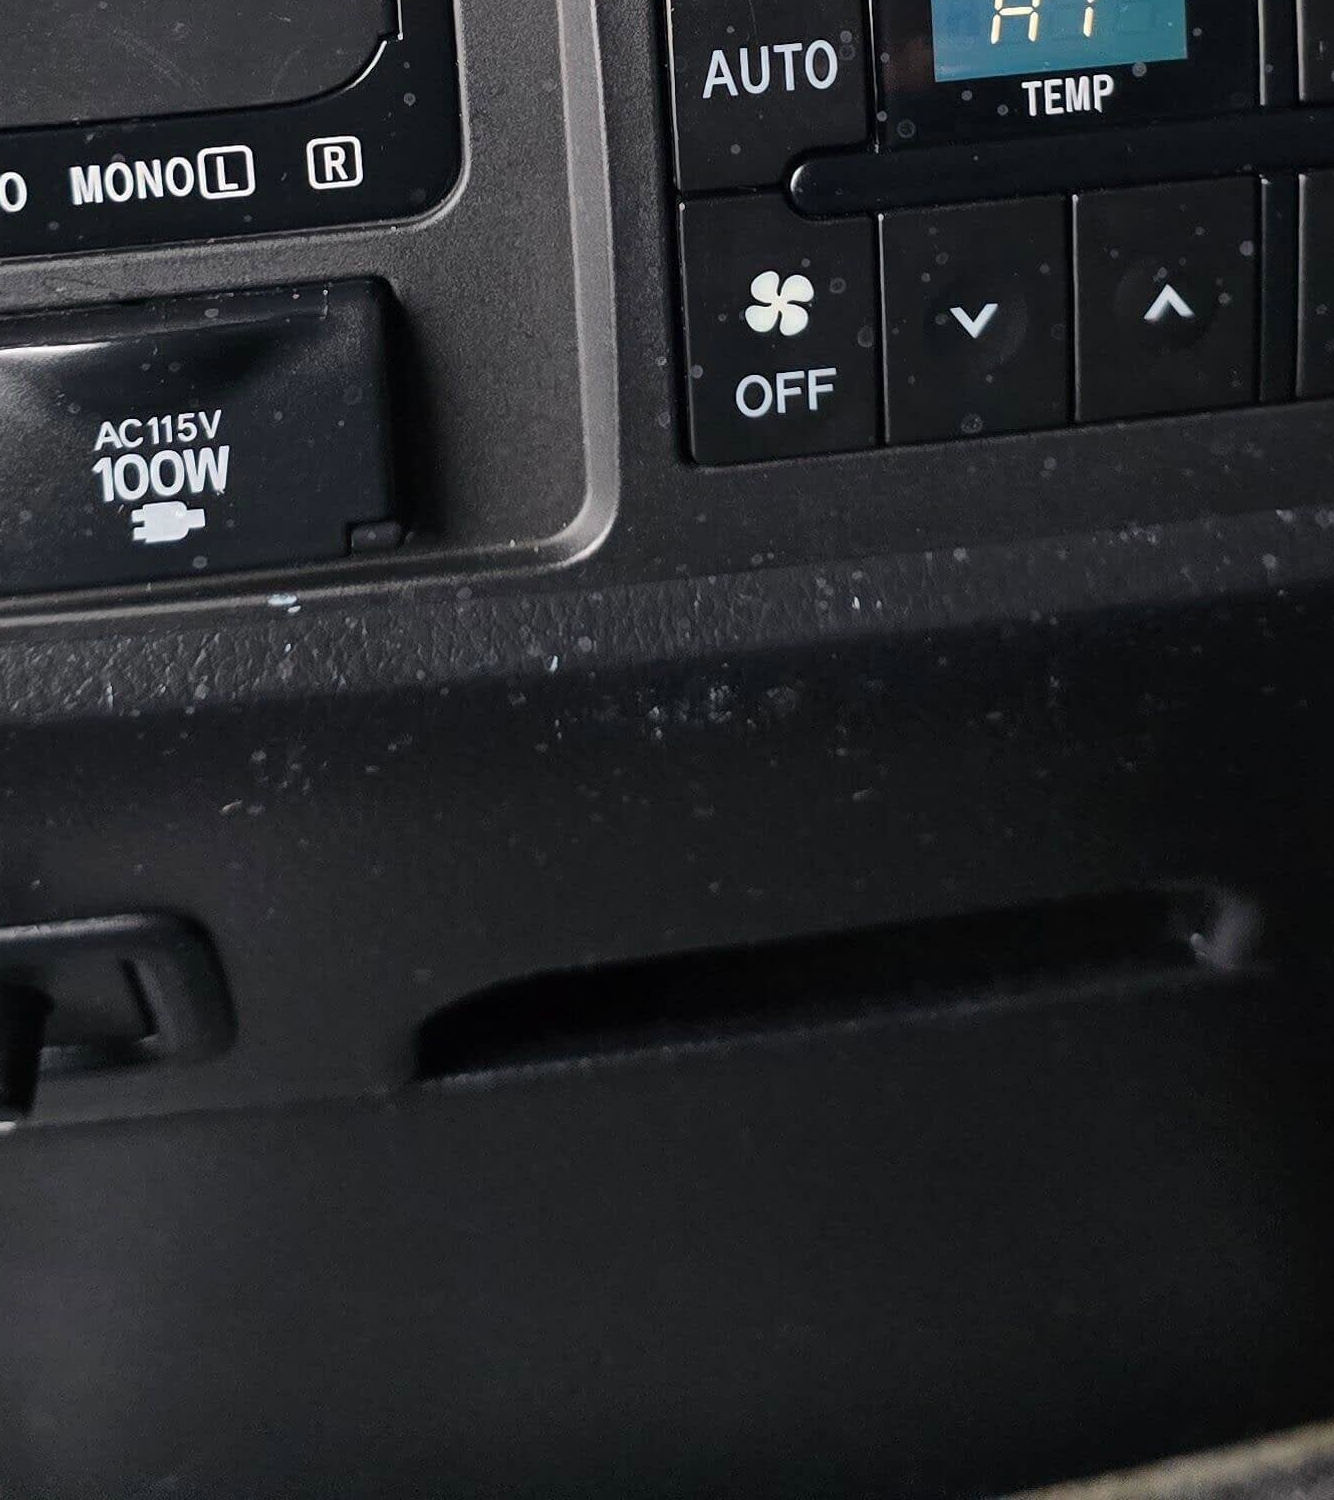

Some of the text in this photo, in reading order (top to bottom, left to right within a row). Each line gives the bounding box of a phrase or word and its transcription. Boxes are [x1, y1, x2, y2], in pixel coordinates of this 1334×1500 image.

[702, 39, 839, 99] AUTO
[1021, 73, 1115, 117] TEMP
[735, 367, 837, 419] OFF
[91, 445, 230, 502] 100W
